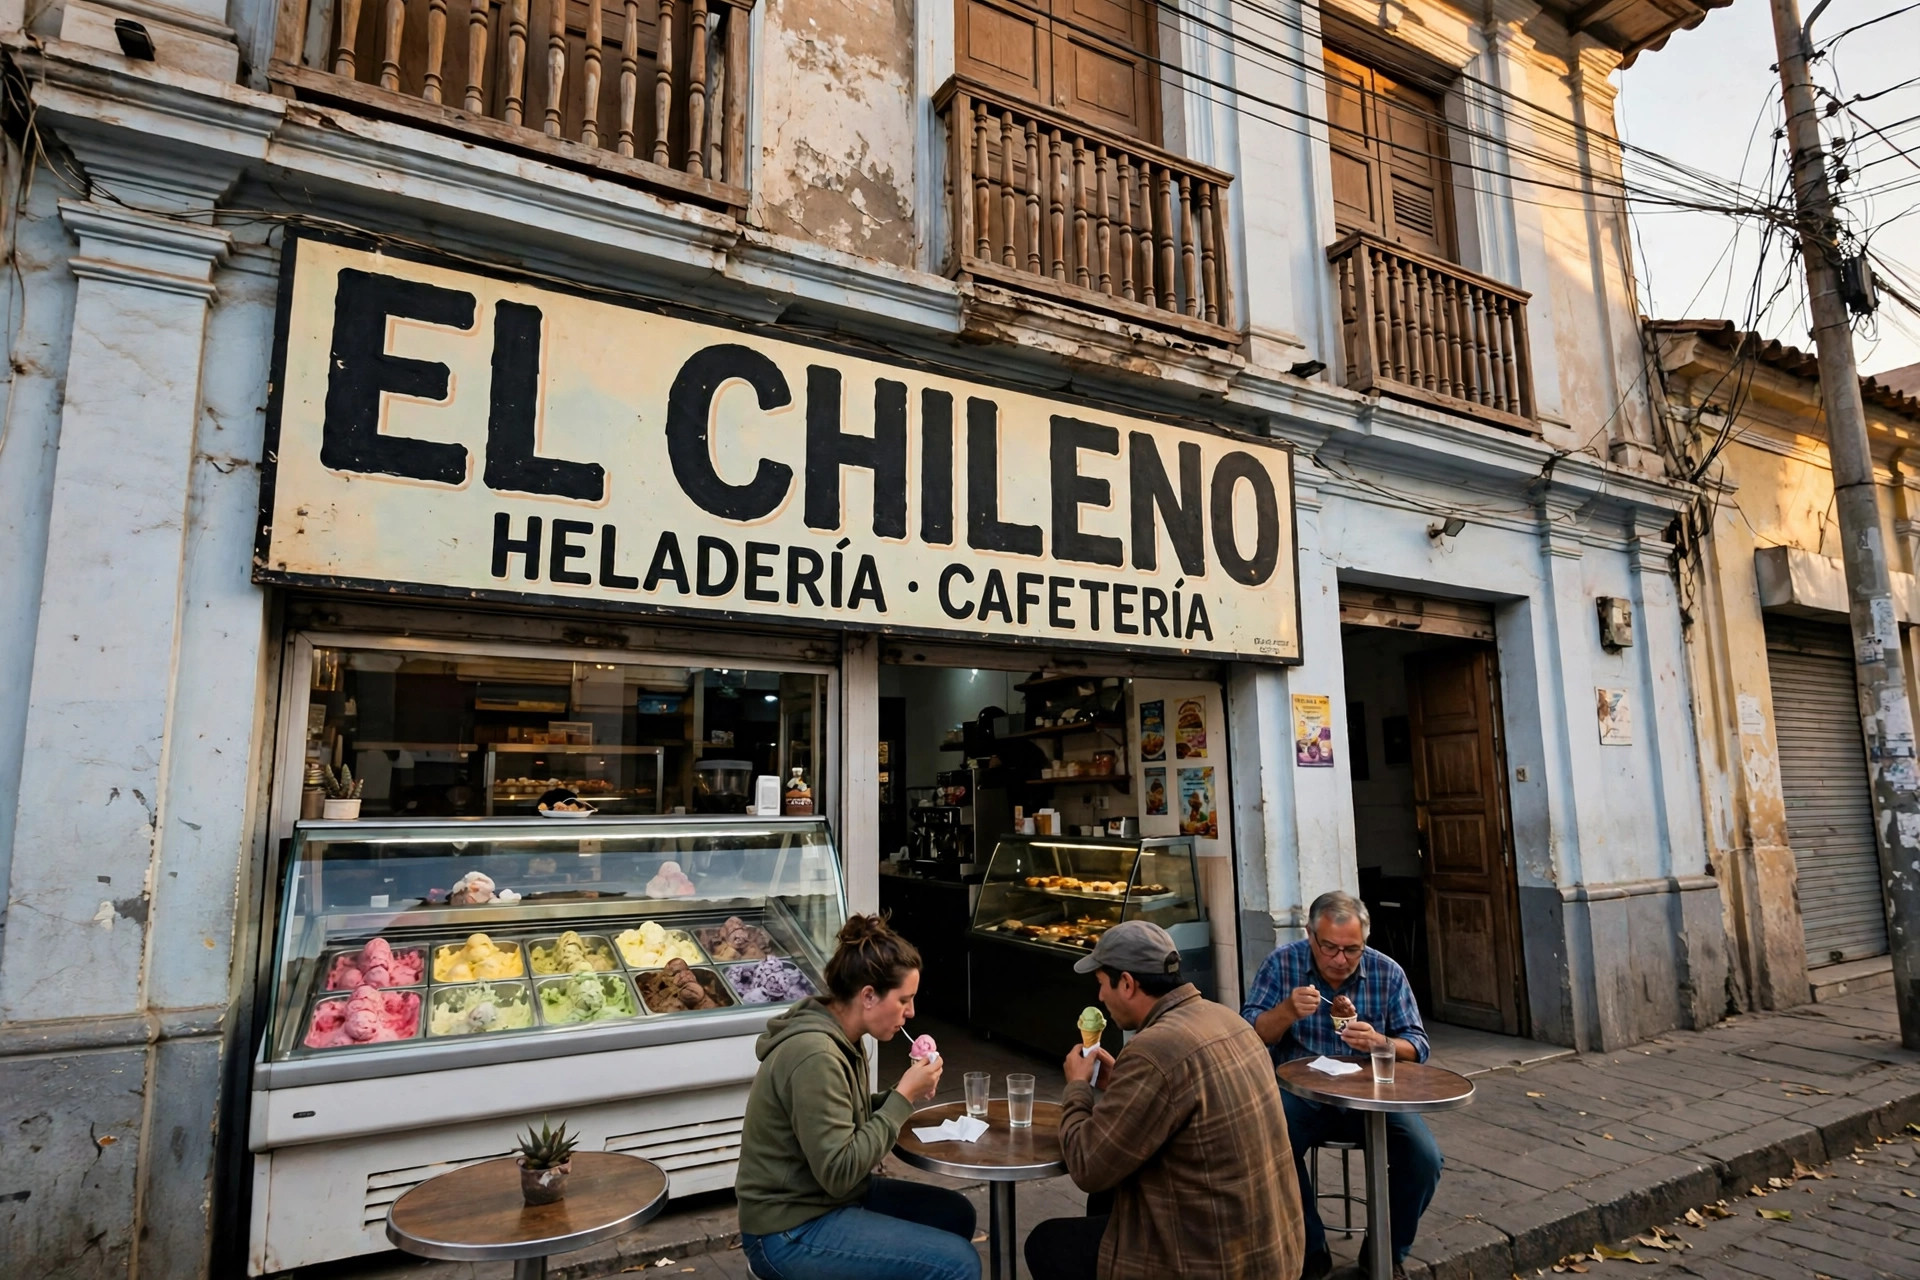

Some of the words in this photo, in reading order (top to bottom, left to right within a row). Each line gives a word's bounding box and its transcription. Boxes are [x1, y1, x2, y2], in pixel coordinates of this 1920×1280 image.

[320, 267, 606, 502] EL
[665, 343, 1280, 587] CHILENO
[491, 512, 887, 613] HELADERÍA
[938, 563, 1214, 641] CAFETERÍA
